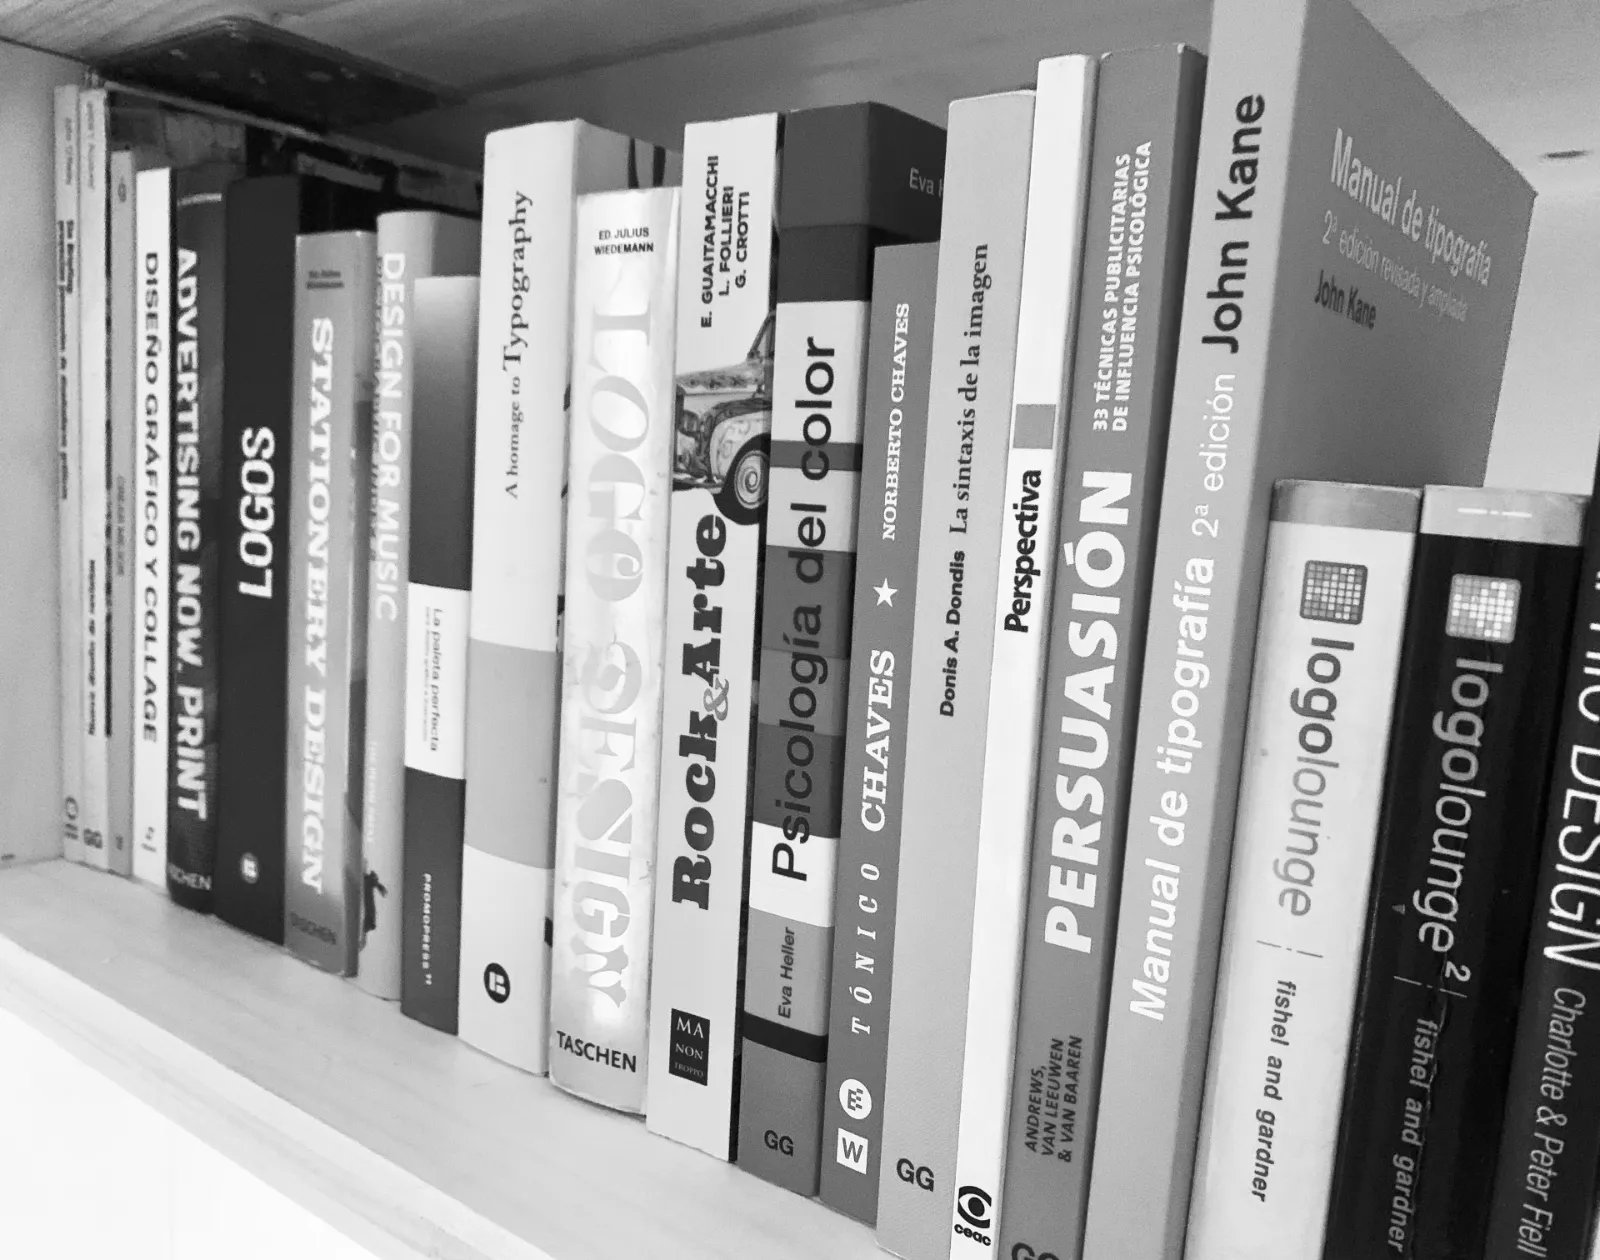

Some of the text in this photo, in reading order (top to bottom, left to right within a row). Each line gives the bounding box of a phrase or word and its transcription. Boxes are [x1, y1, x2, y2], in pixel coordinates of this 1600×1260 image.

[909, 166, 935, 196] Eva
[1214, 93, 1266, 222] Kane
[1330, 126, 1491, 287] Manual de tipografía
[594, 242, 654, 256] WIEDEMANN
[614, 227, 650, 239] JULIUS
[701, 155, 719, 328] E. GUAITAMACCHI
[718, 185, 734, 296] L. FOLLIERI
[735, 191, 750, 289] G. CROTTI
[1093, 152, 1131, 432] 33 TÉCNICAS PUBLICITARIAS
[1112, 140, 1152, 432] DE INFLUENCIA PSICOLÓGICA
[1201, 240, 1250, 354] John
[1339, 225, 1380, 274] edición
[1418, 281, 1429, 309] y
[145, 252, 162, 384] DISEÑO
[502, 190, 533, 500] A homage to Typography
[1314, 269, 1377, 330] John Kane
[304, 317, 334, 677] STATIONERY
[374, 253, 406, 622] DESIGN FOR MUSIC
[939, 243, 993, 717] Donis A. Dondis La sintaxis de la imagen
[1199, 372, 1236, 493] edición
[145, 558, 158, 578] Y
[176, 247, 207, 821] ADVERTISING NOW. PRINT
[238, 427, 275, 599] LOGOS
[1004, 469, 1042, 633] Perspectiva
[143, 586, 158, 744] COLLAGE
[772, 336, 835, 882] Psicología del color
[849, 303, 910, 1035] TÓNICO CHAVES NORBERTO CHAVES
[1156, 556, 1215, 775] tipografía
[430, 608, 444, 752] La paleta perfecta
[1044, 470, 1133, 955] PERSUASIÓN
[301, 683, 327, 894] DESIGN
[1149, 789, 1189, 848] de
[1273, 636, 1356, 918] logolounge
[421, 873, 432, 969] PROMOPRESS
[778, 927, 796, 1019] Eva Heller
[1129, 856, 1182, 1023] Manual
[556, 1030, 637, 1073] TASCHEN
[675, 1042, 704, 1060] NON
[676, 1016, 705, 1039] MA
[1251, 978, 1297, 1203] fishel and gardner
[764, 1130, 794, 1156] GG
[842, 1137, 864, 1163] W
[1025, 1065, 1047, 1152] ANDREWS,
[1041, 1037, 1065, 1157] VAN LEEUWEN
[1057, 1034, 1083, 1164] & VAN BAAREN
[1387, 1017, 1439, 1254] fishel and gardner
[1516, 986, 1587, 1258] Charlotte & Peter Fiell
[896, 1157, 935, 1193] GG
[954, 1223, 992, 1247] ceac
